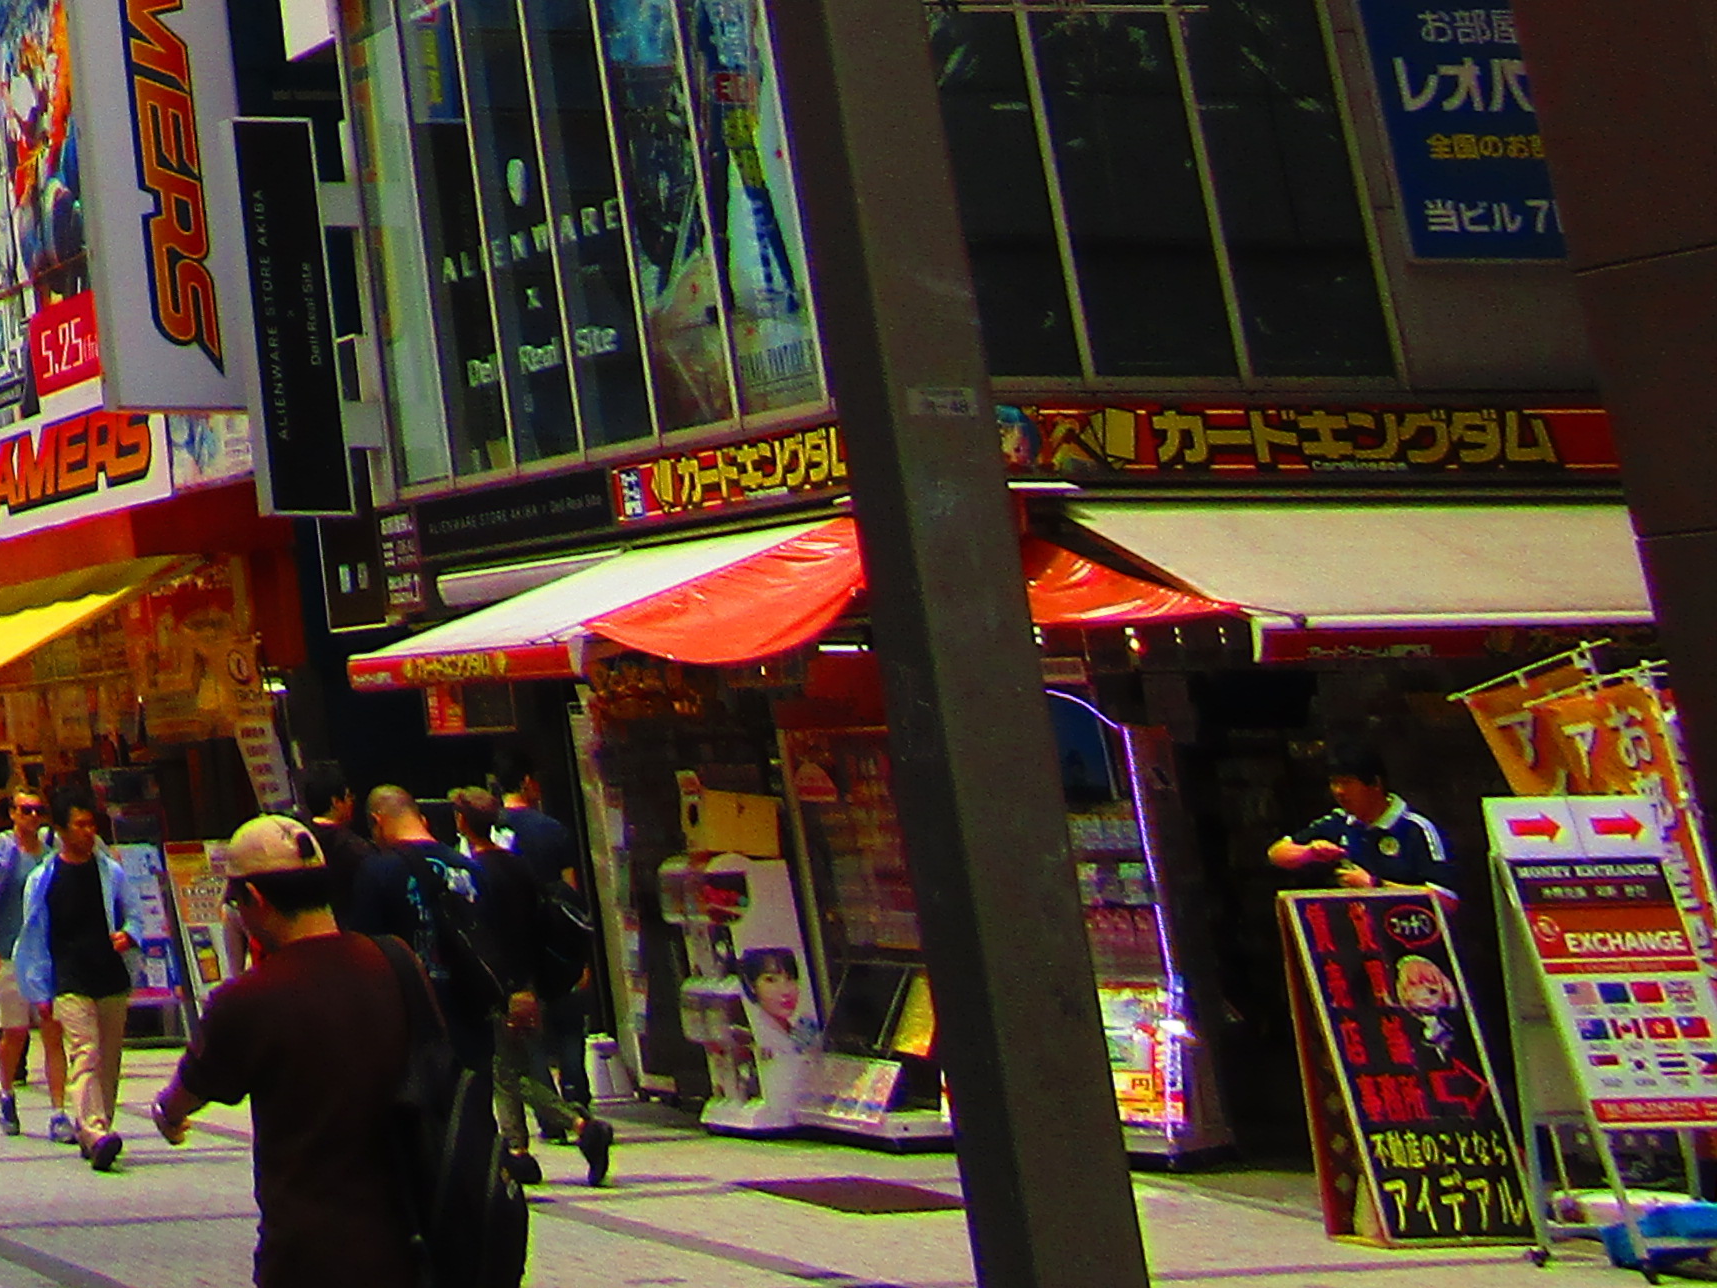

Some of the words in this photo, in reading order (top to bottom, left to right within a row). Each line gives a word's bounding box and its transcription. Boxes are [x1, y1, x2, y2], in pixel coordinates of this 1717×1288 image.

[253, 188, 268, 248] AKIBA
[1423, 199, 1522, 234] 当ビル
[520, 344, 561, 375] Real
[575, 324, 618, 358] Site
[1153, 409, 1558, 464] カードキングダム
[1564, 930, 1688, 954] EXCHANGE
[1382, 1171, 1526, 1232] アイデアル
